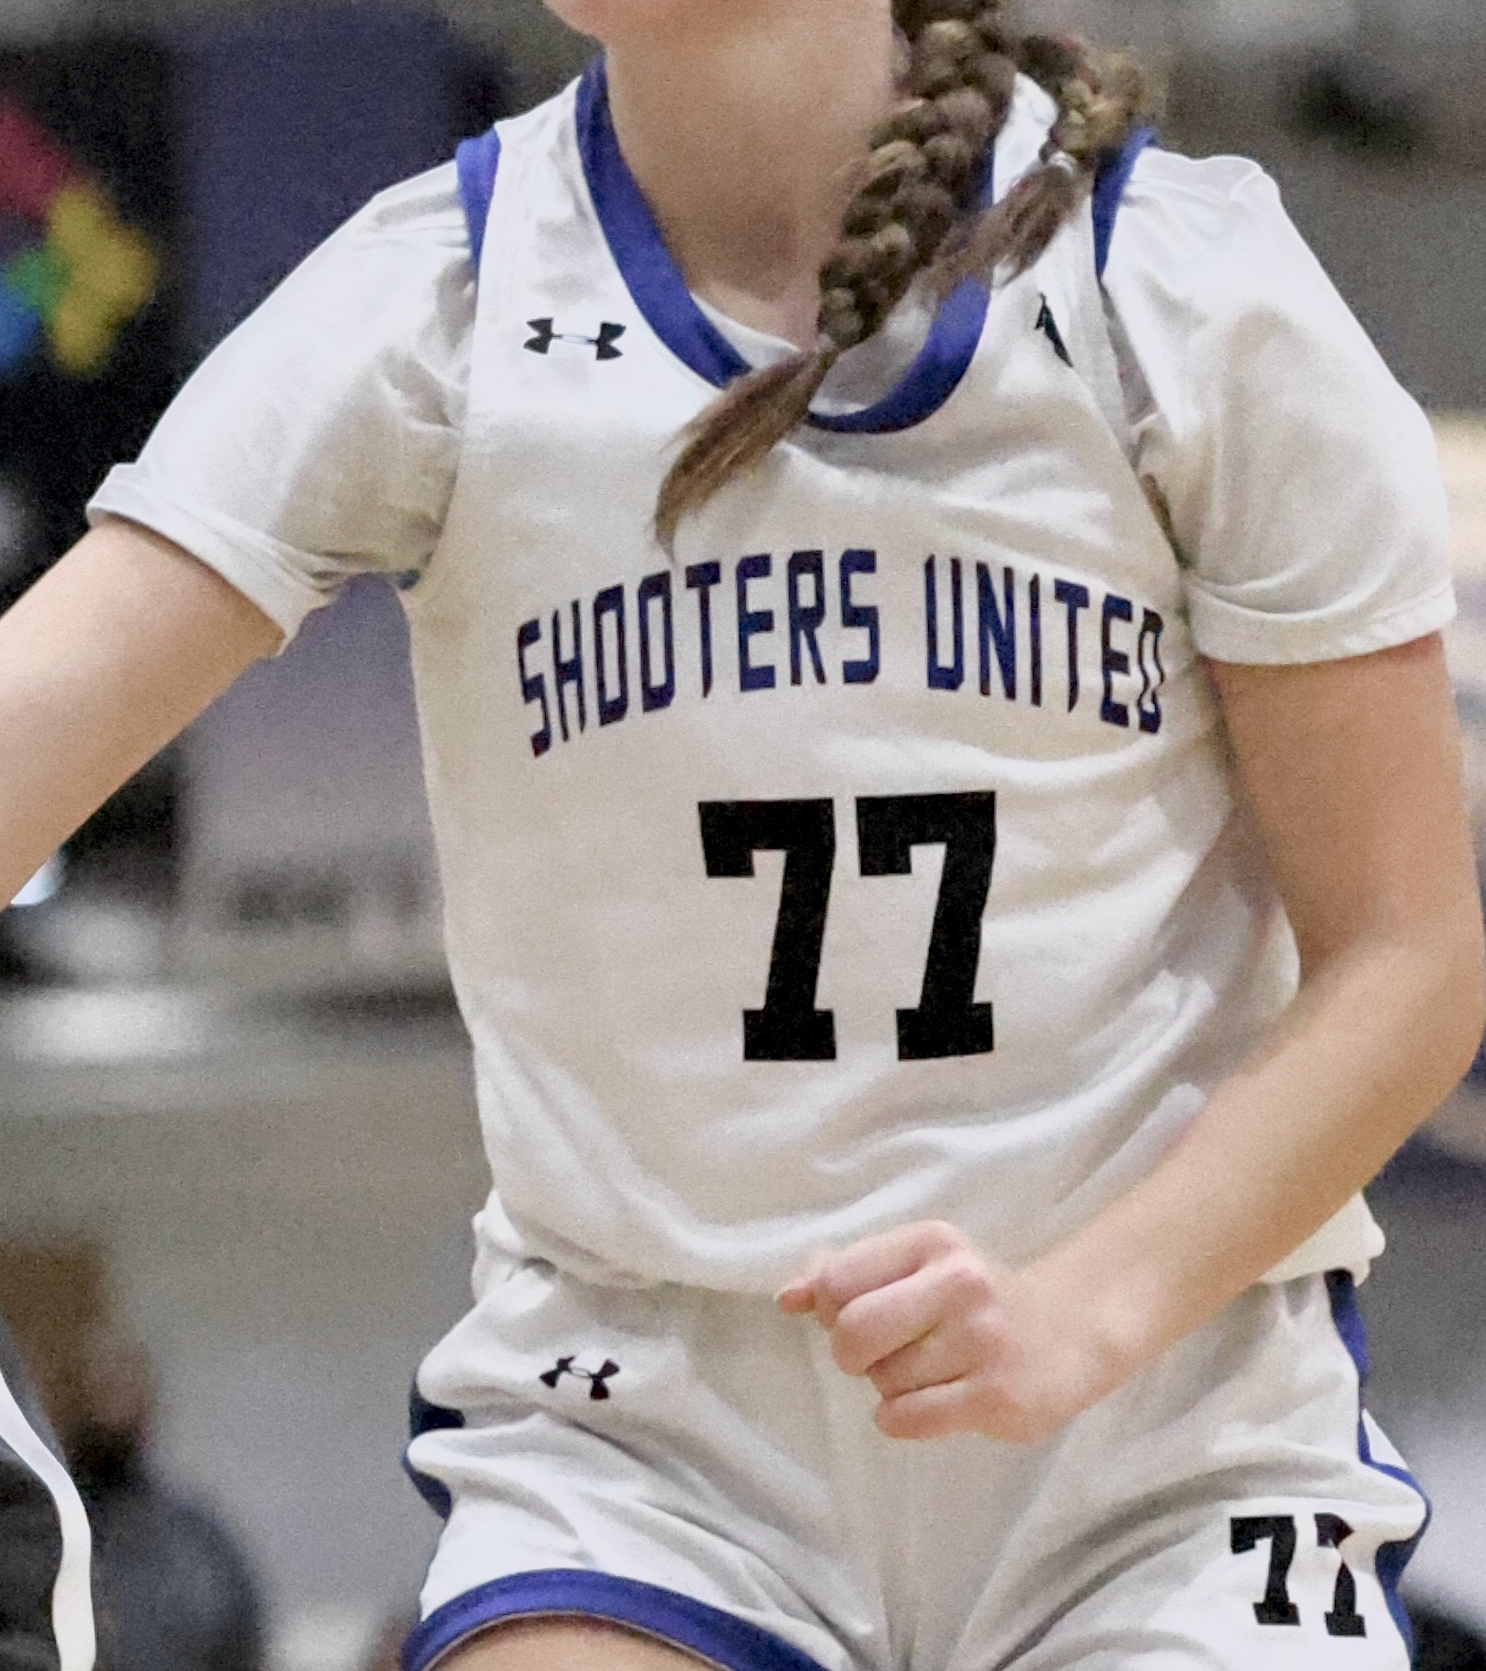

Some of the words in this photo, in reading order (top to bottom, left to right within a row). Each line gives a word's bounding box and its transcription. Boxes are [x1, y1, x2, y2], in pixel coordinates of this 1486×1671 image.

[517, 548, 881, 758] SHOOTERS
[924, 555, 1166, 734] UNITED
[697, 790, 998, 1062] 77
